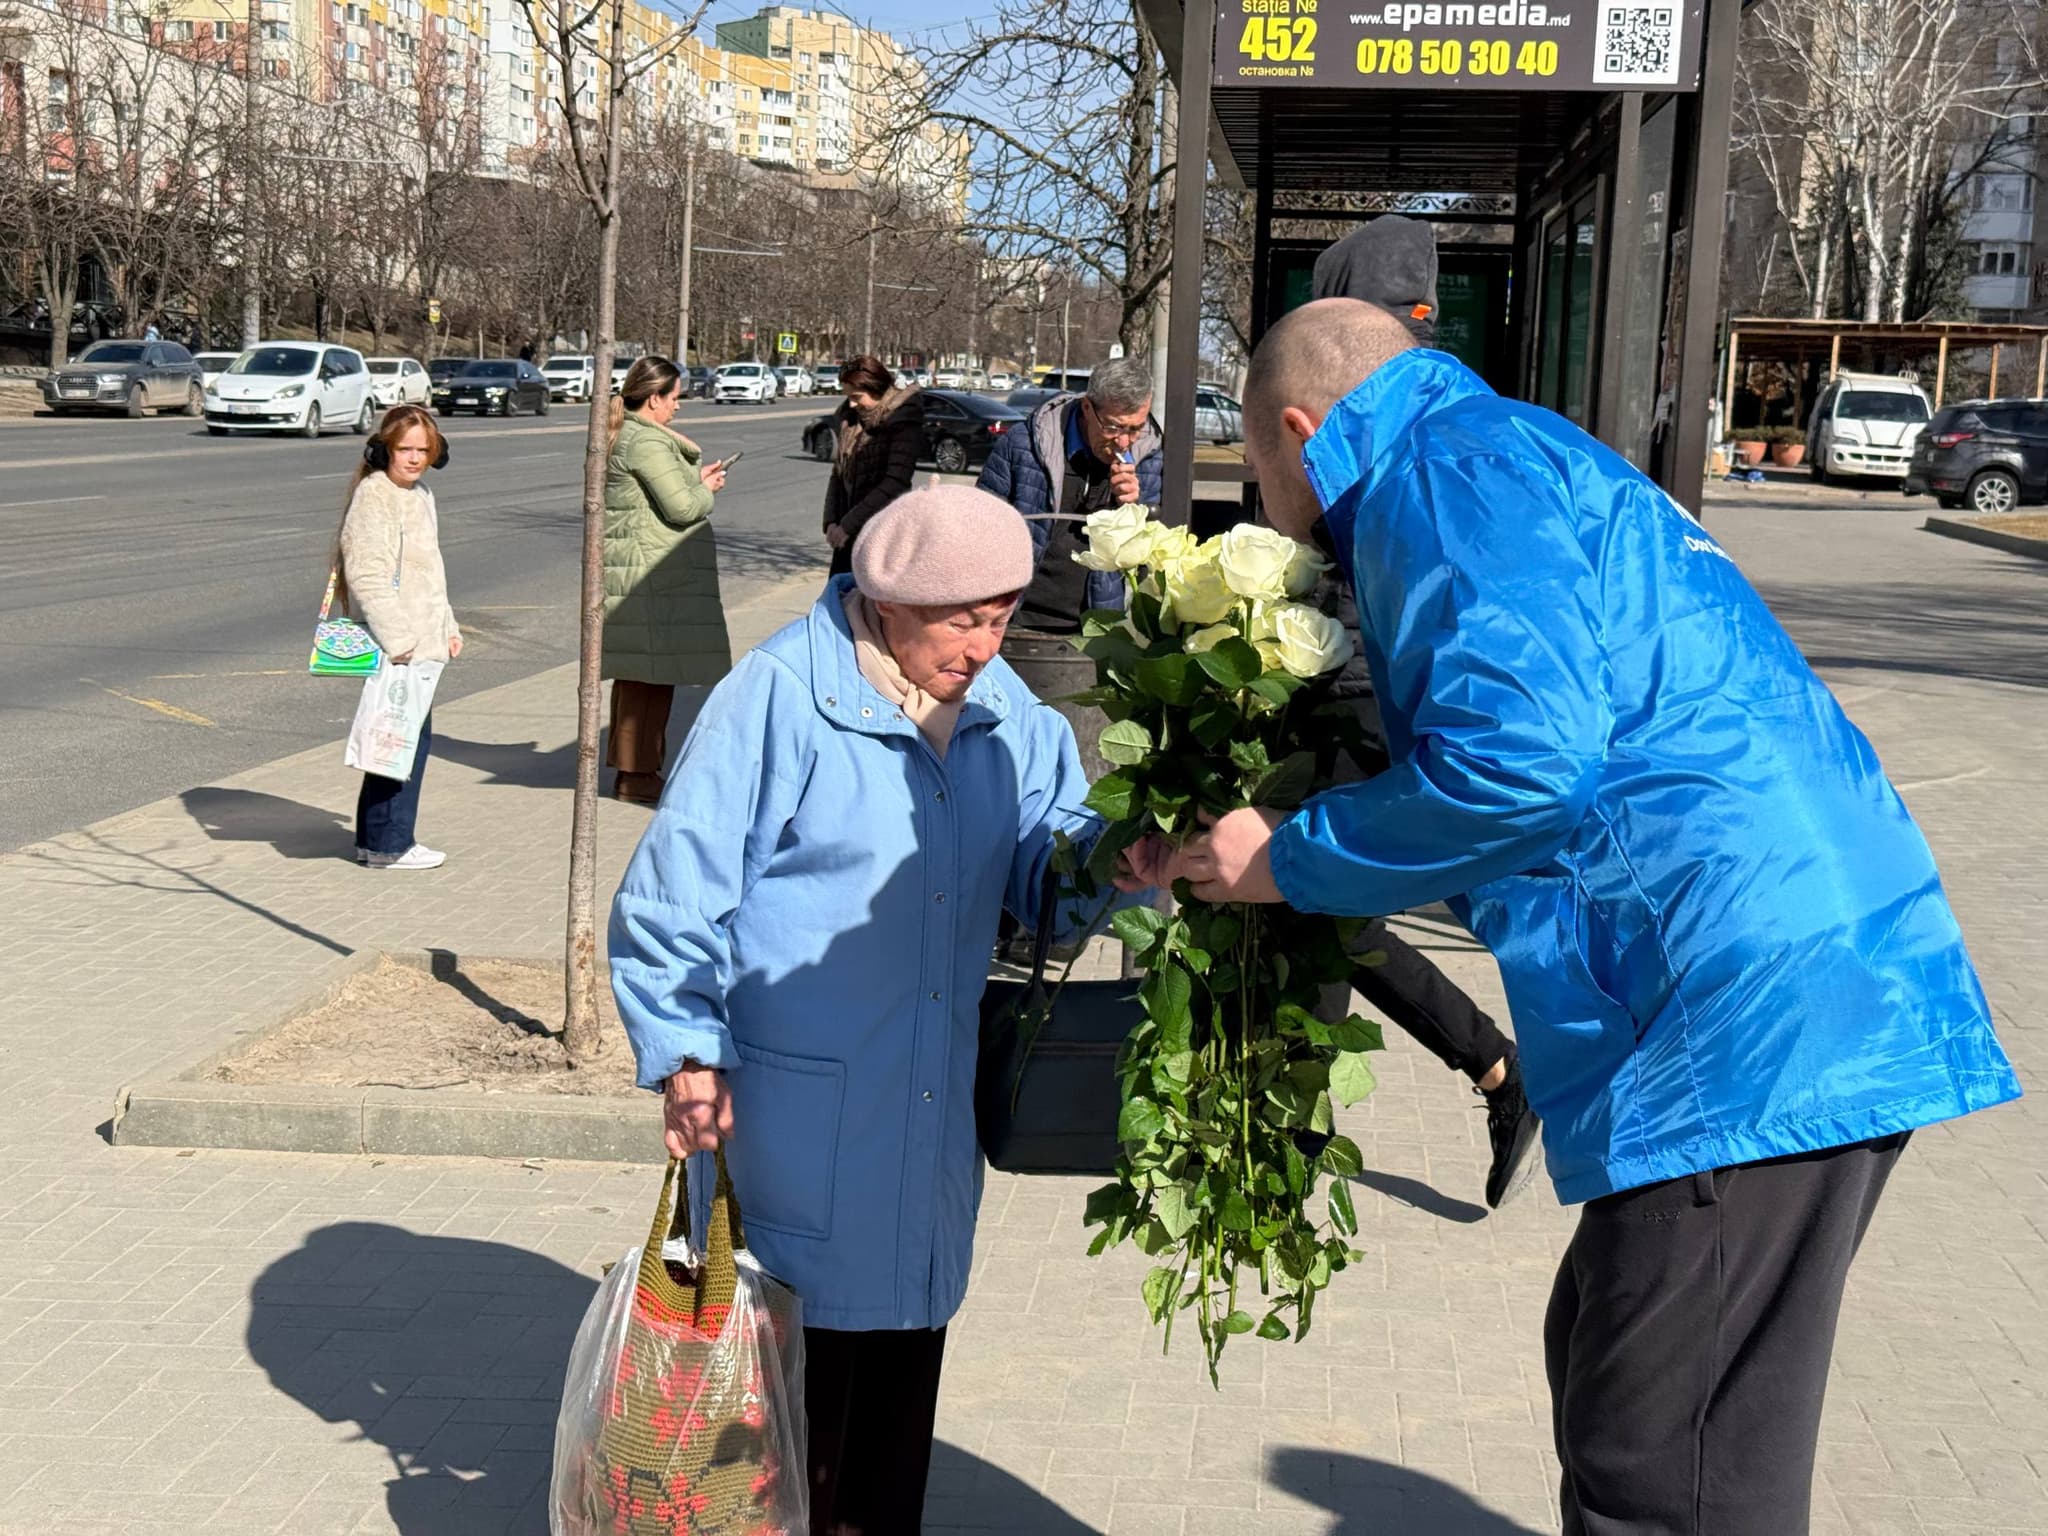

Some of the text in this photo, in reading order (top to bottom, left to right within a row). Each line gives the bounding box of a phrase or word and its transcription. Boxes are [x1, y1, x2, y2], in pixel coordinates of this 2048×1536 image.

[1349, 0, 1571, 31] www.epamedia.md
[1239, 16, 1318, 61] 452
[1239, 66, 1297, 76] остановка
[1356, 38, 1558, 76] 078 50 30 40
